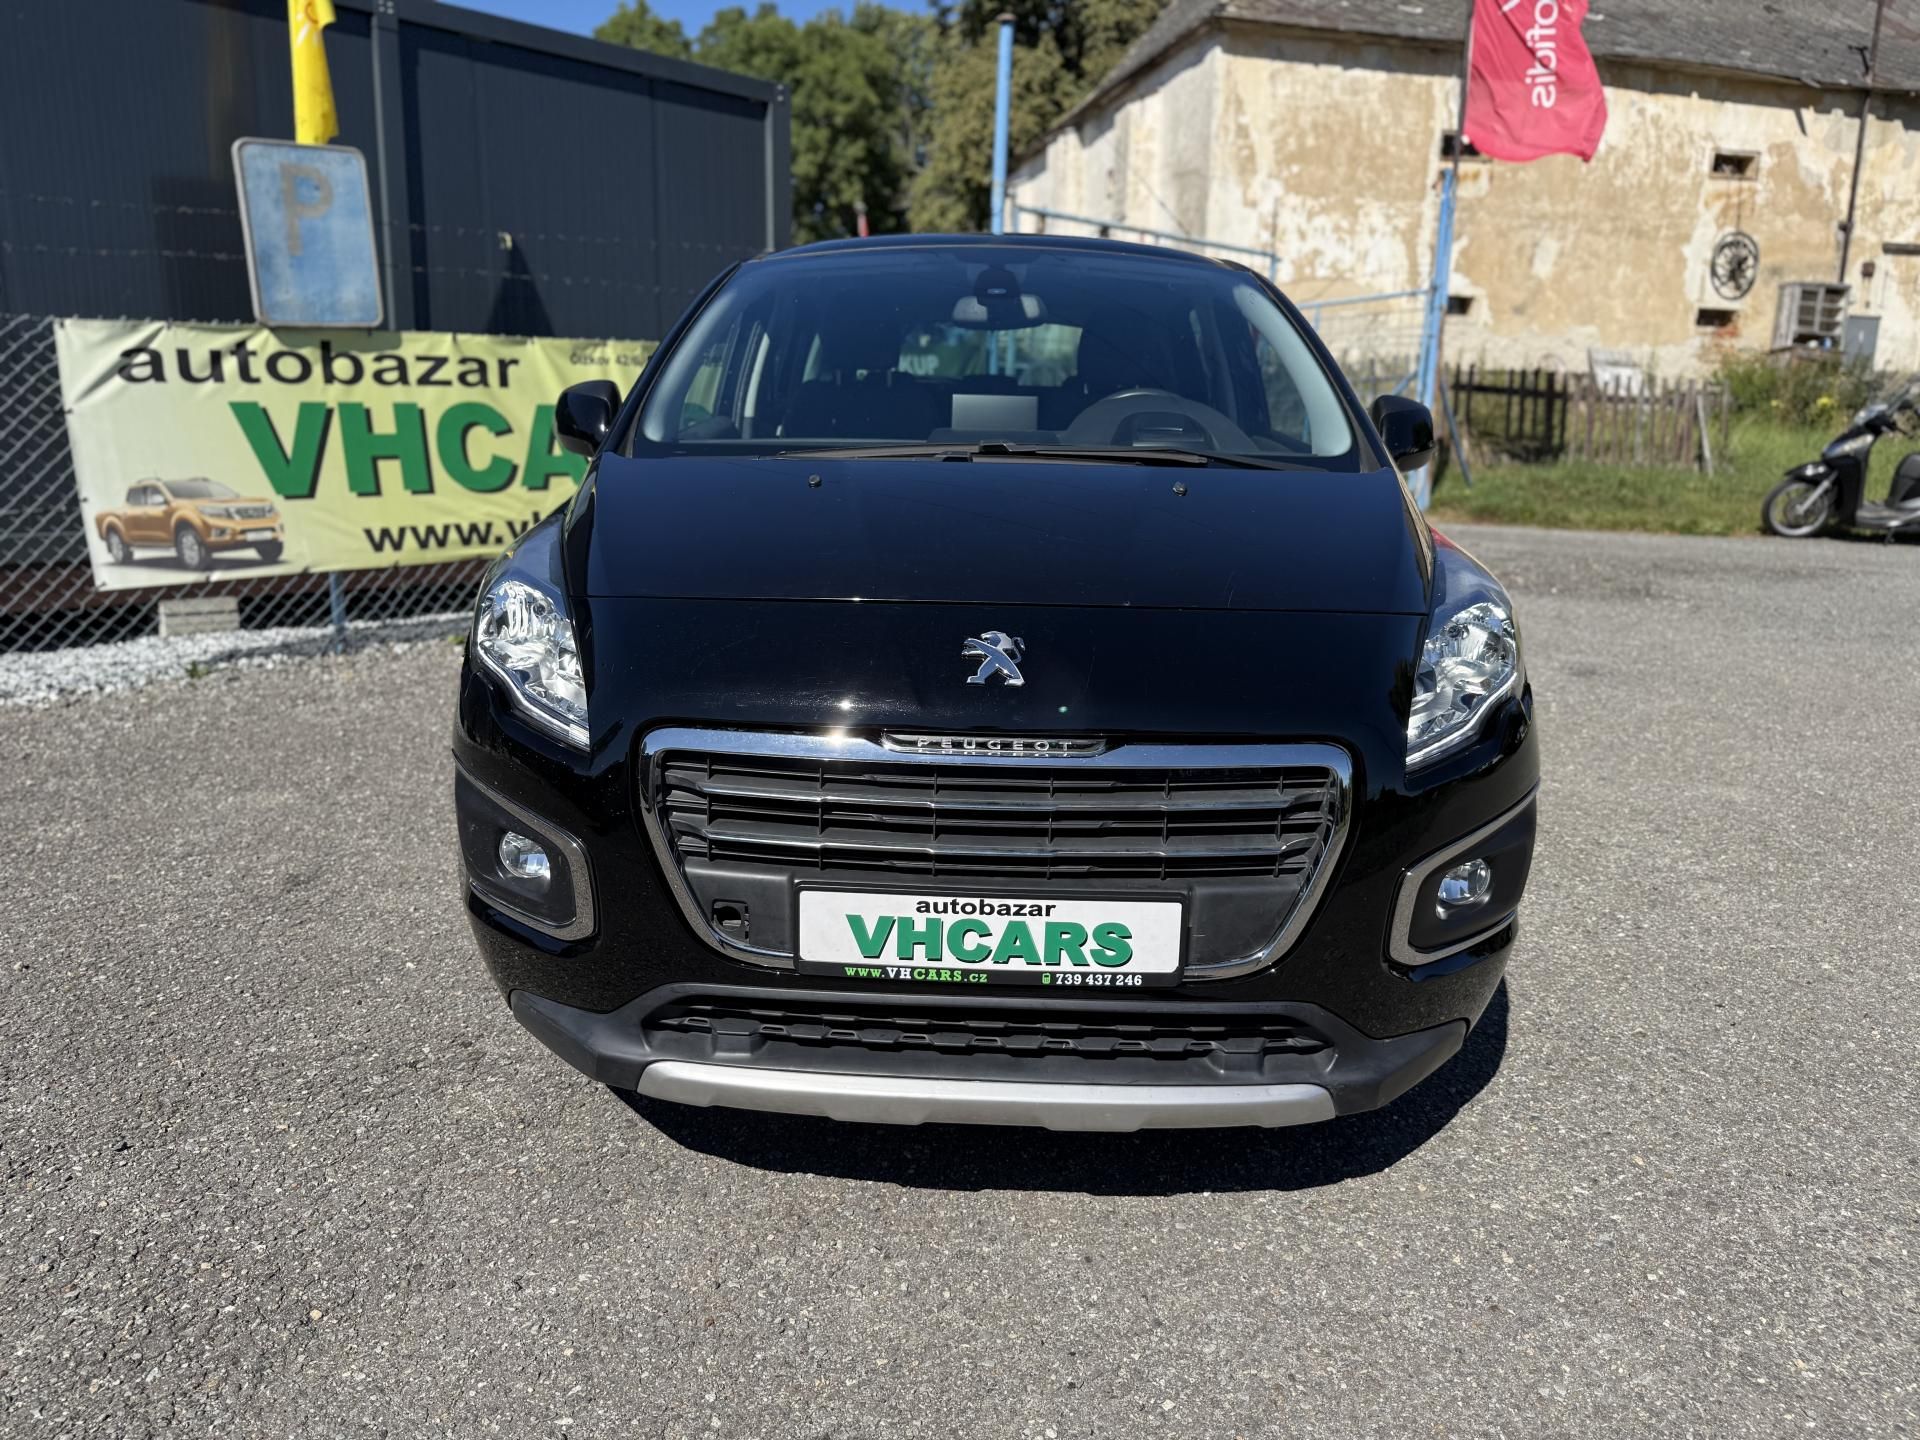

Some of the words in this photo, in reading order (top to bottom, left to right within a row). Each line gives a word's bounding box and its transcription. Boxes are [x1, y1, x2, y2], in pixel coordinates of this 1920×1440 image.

[279, 161, 333, 256] P
[118, 339, 520, 389] autobazar
[917, 736, 1072, 752] PEUGEOT
[915, 898, 1056, 917] autobazar
[845, 914, 1133, 967] VHCARS
[845, 967, 987, 983] www.VHCARS.cz
[1055, 973, 1082, 985] 739
[1085, 973, 1112, 985] 437
[1115, 974, 1142, 986] 246
